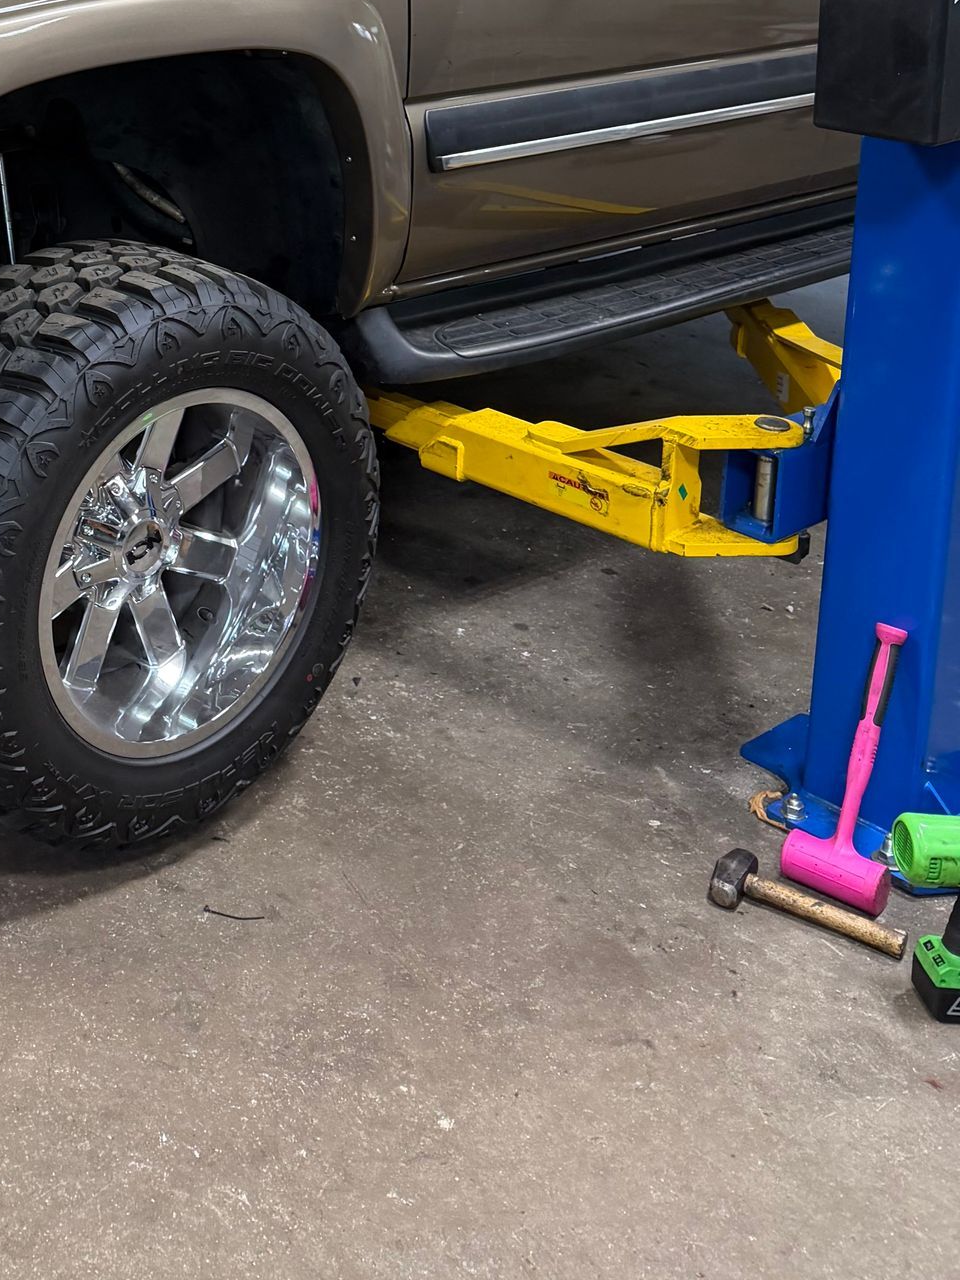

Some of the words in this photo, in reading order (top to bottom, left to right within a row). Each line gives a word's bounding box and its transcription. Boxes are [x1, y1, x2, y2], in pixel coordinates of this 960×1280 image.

[225, 350, 275, 368] BIG
[273, 361, 348, 447] POWER
[125, 529, 162, 566] ION
